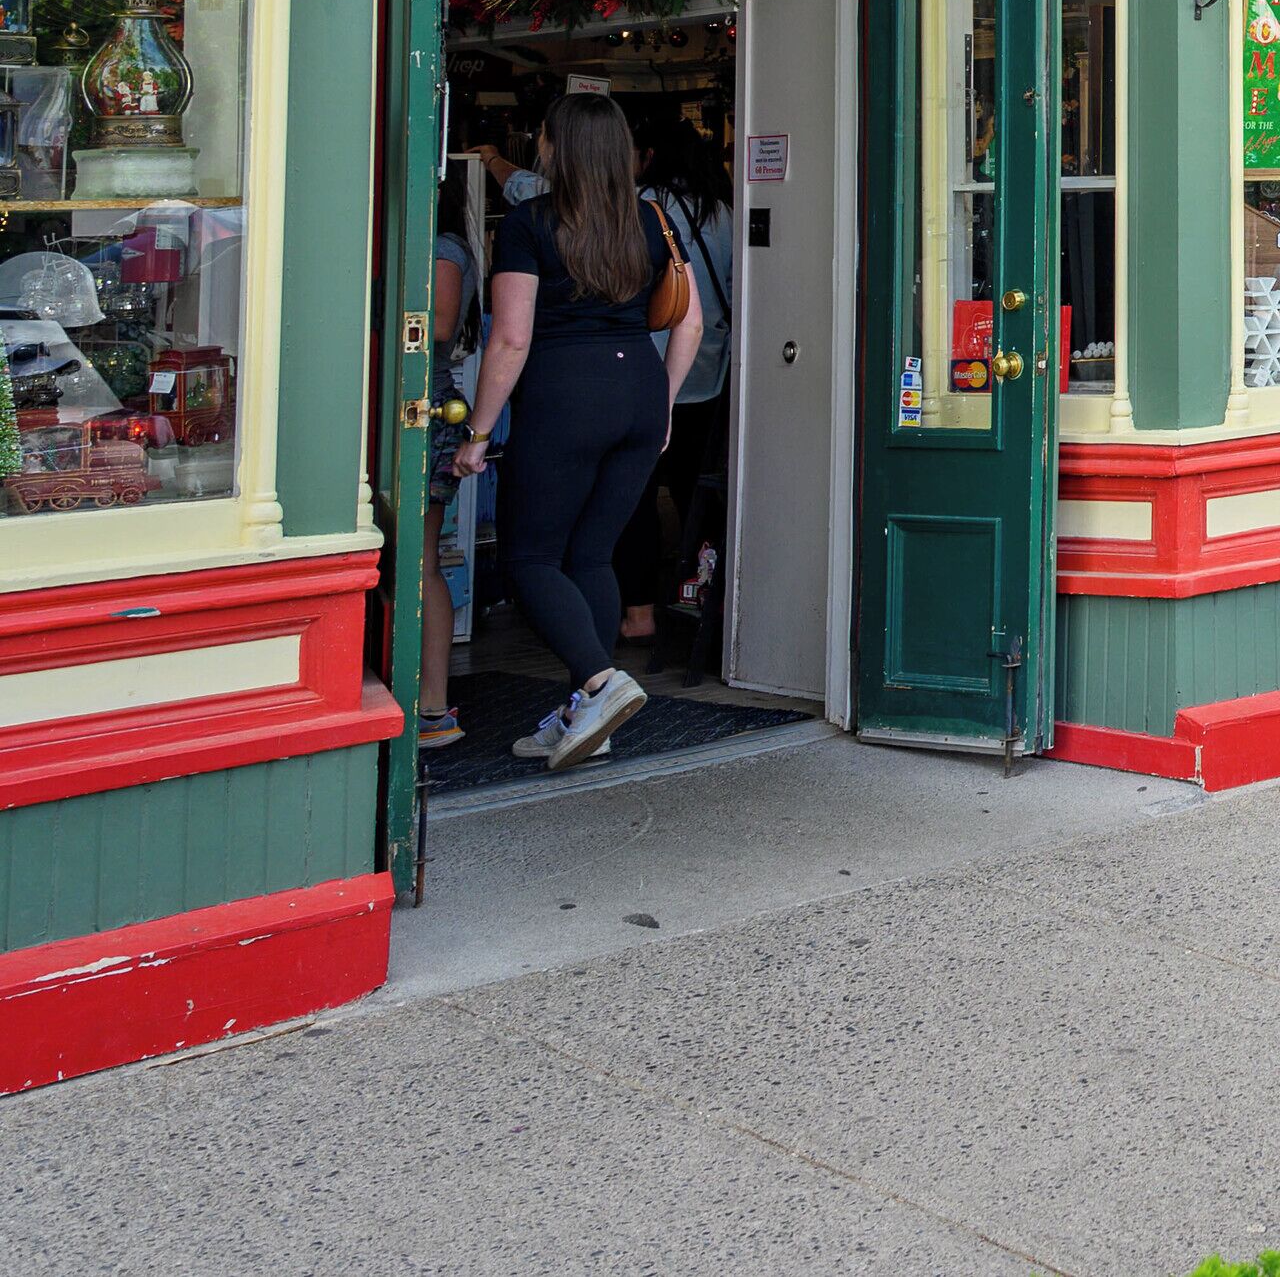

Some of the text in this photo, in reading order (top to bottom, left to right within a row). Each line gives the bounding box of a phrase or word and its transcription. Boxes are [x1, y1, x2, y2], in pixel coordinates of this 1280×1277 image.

[1259, 121, 1274, 130] THE
[954, 370, 987, 381] MasterCard
[904, 413, 918, 421] VISA
